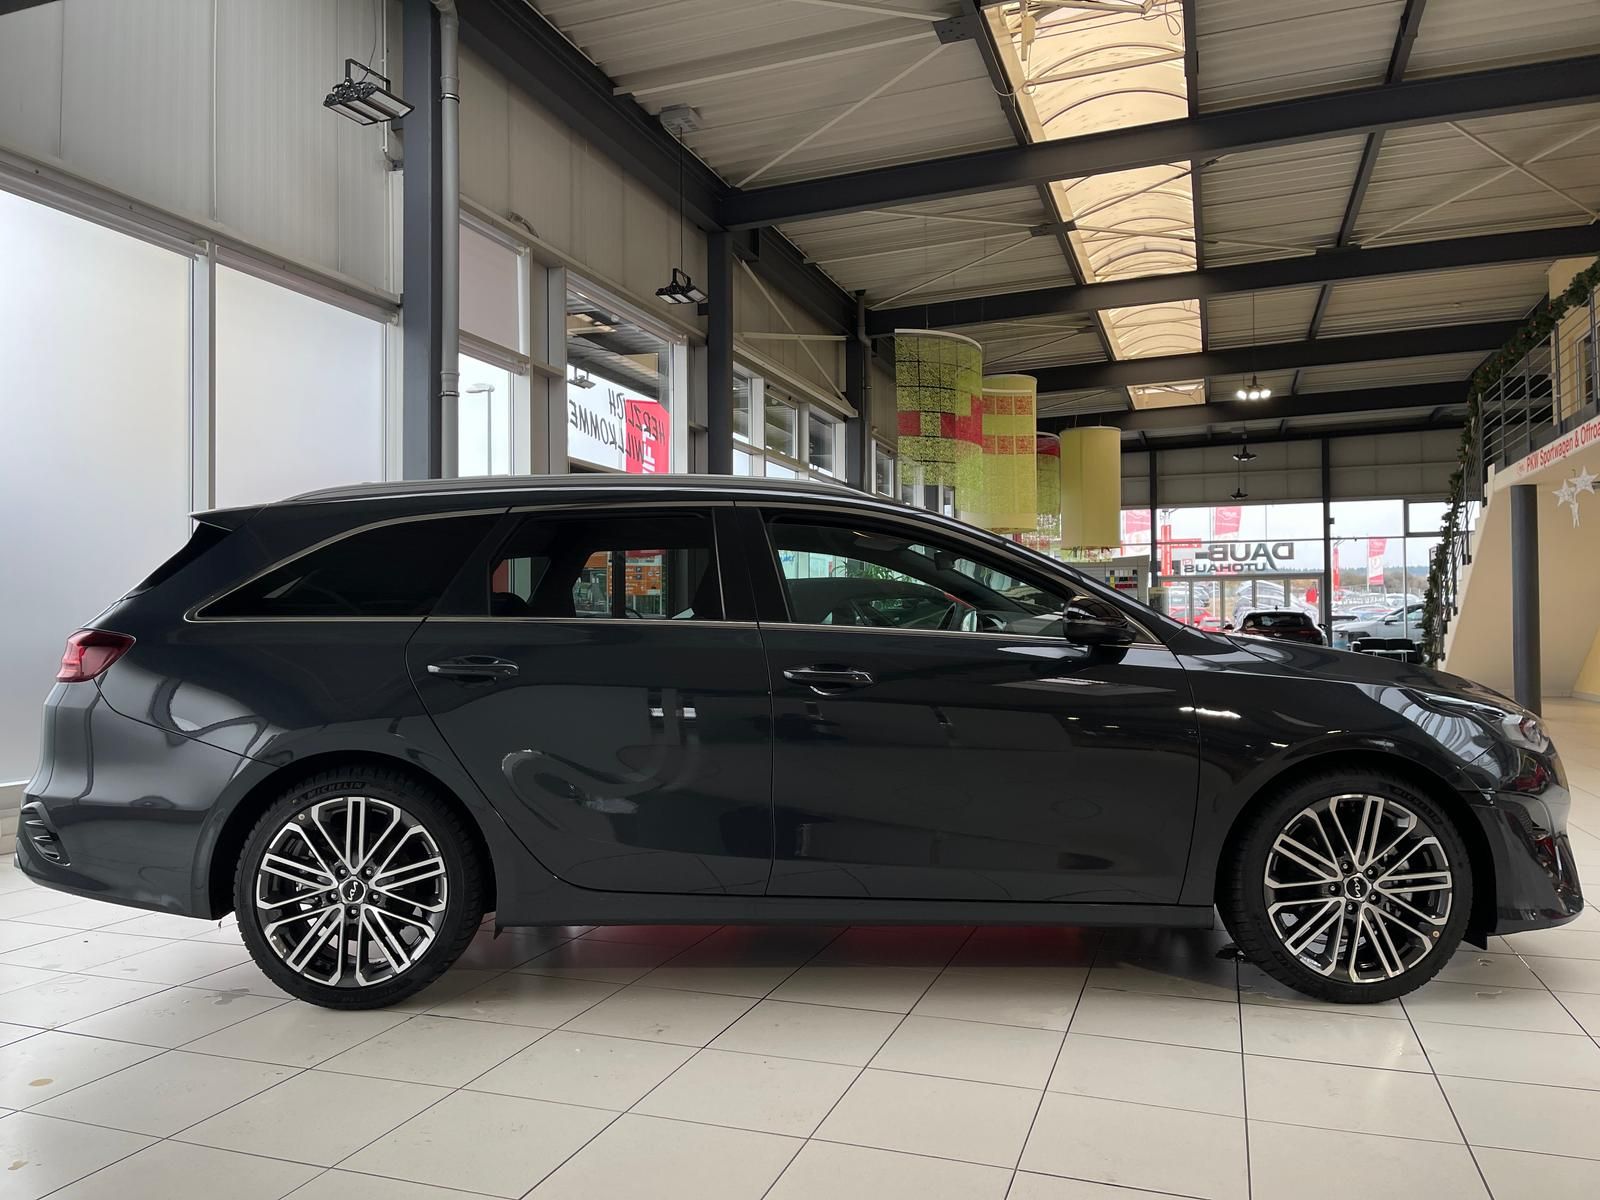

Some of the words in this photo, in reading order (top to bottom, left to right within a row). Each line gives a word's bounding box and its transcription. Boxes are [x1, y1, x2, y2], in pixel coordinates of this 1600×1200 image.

[1526, 451, 1540, 473] PKW
[1539, 437, 1574, 467] Sportwagen
[1574, 430, 1580, 449] &
[307, 782, 365, 799] MICHELIN
